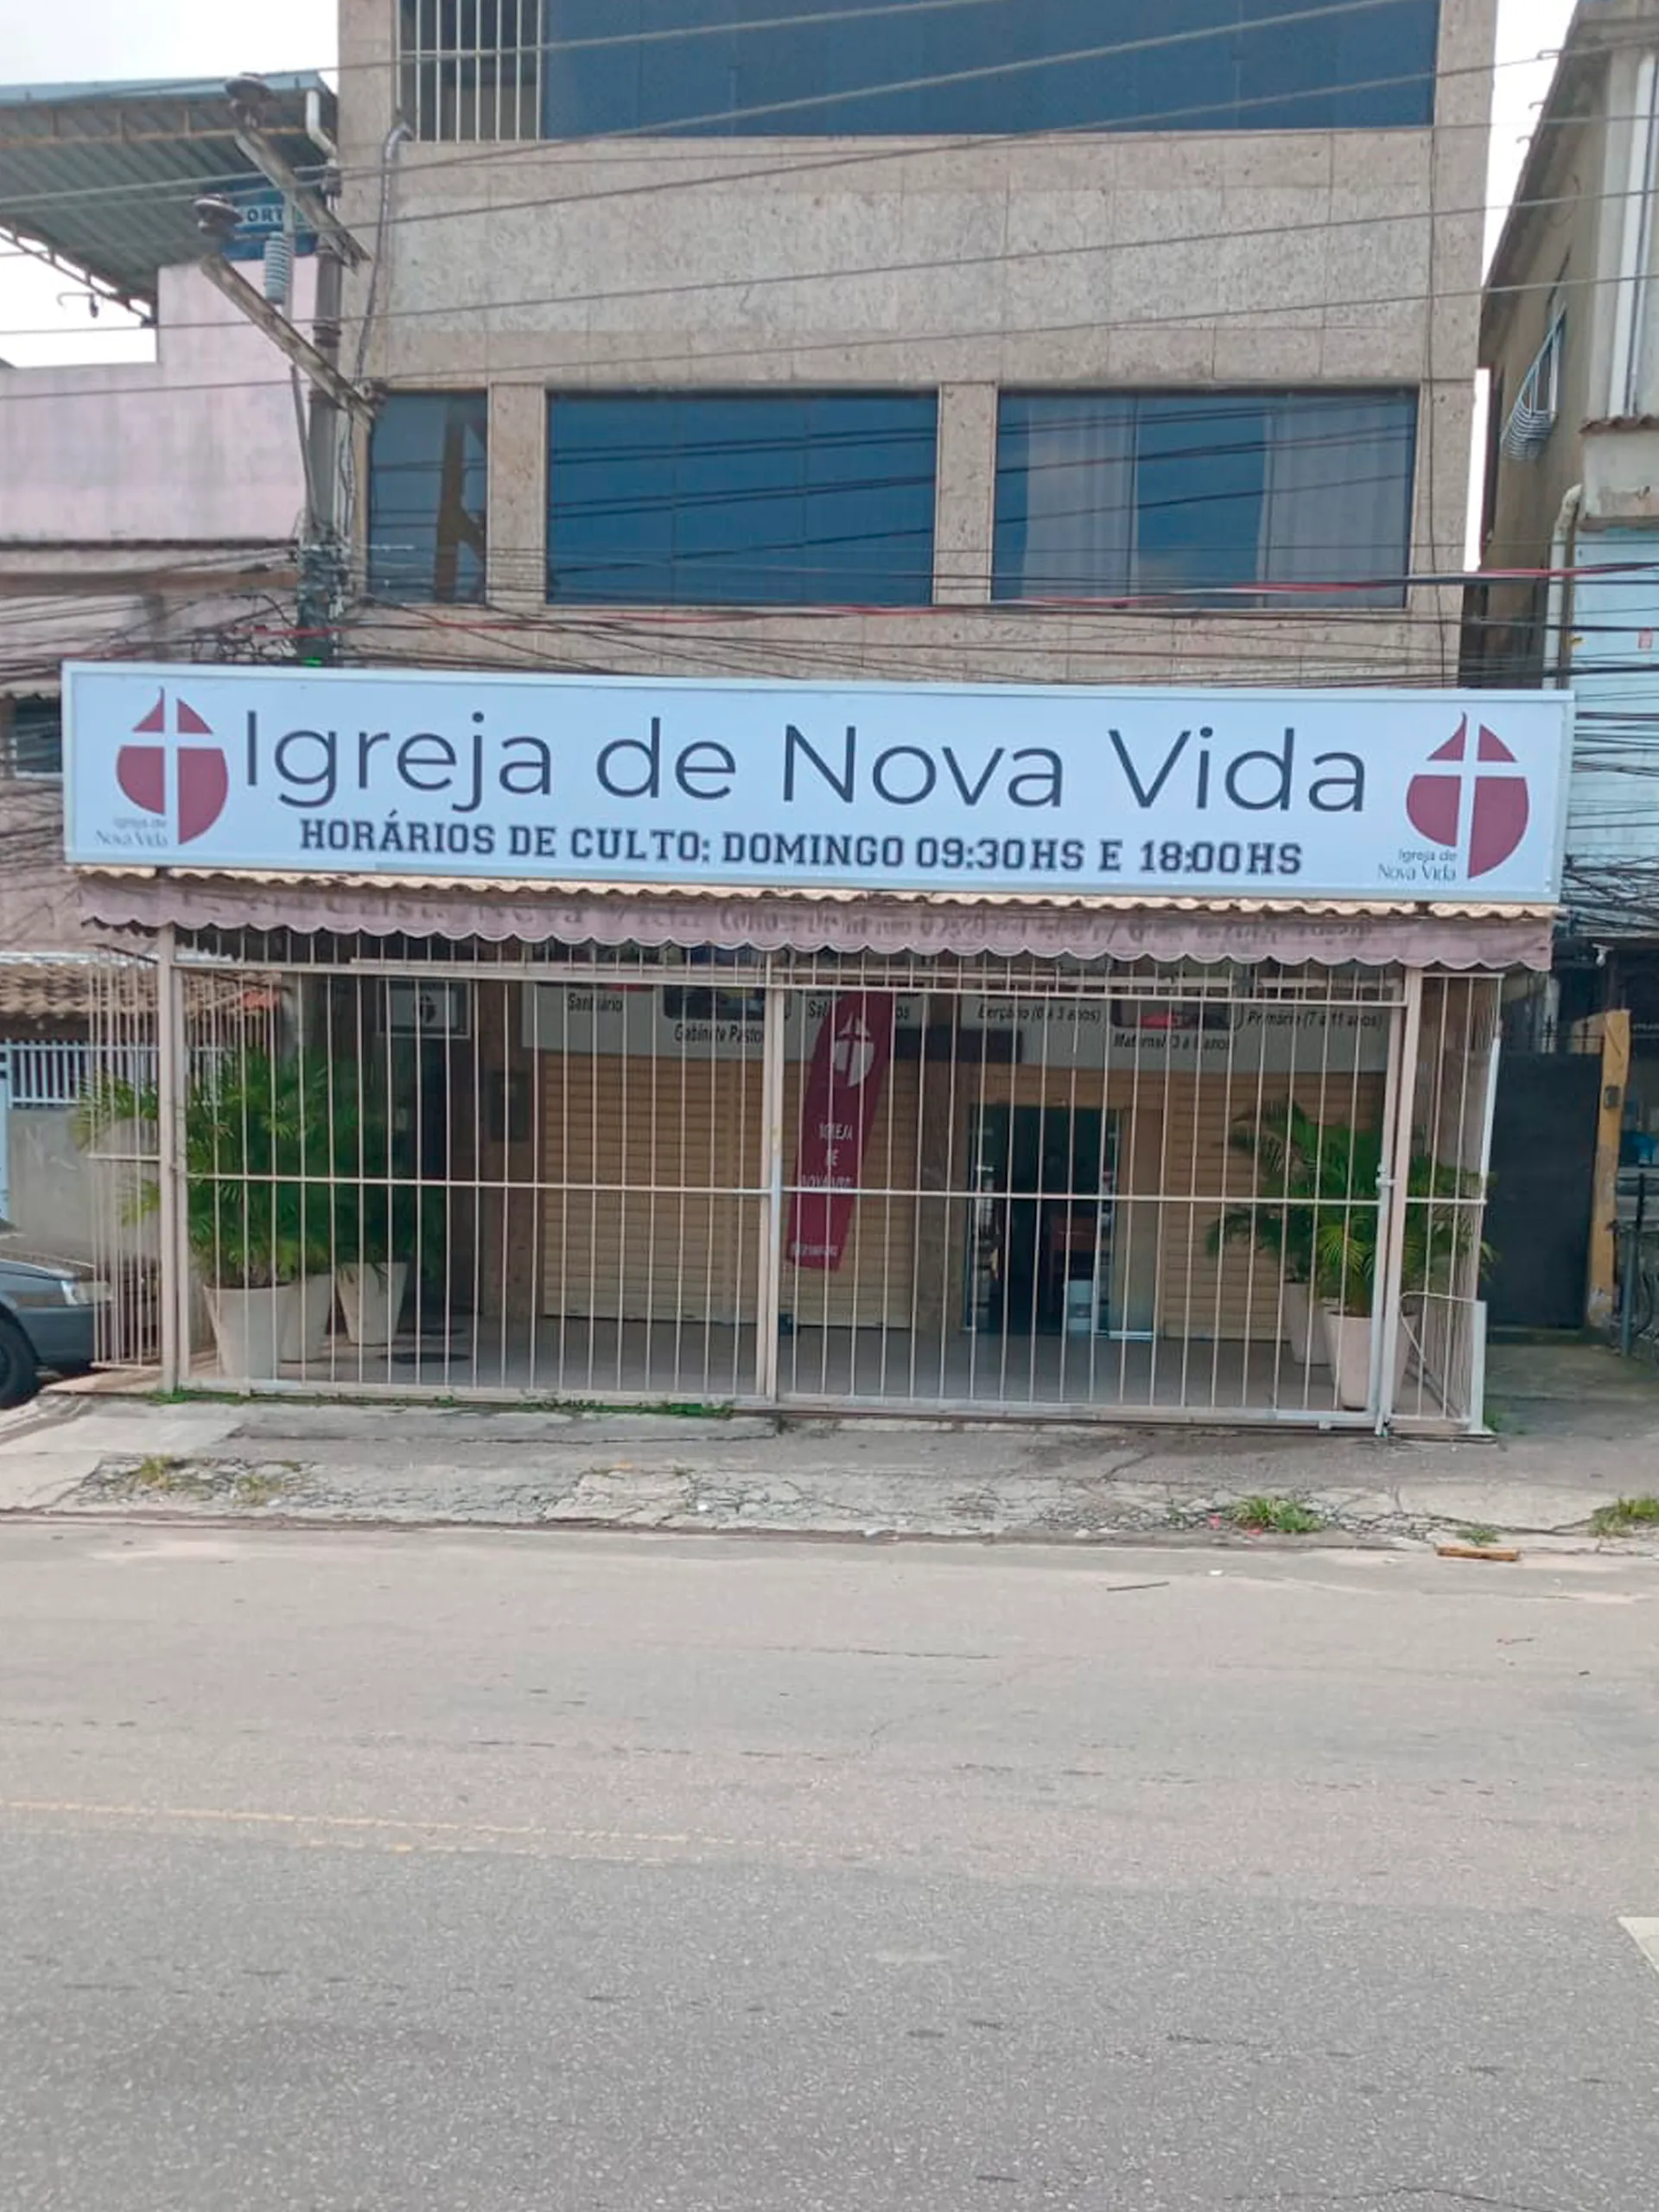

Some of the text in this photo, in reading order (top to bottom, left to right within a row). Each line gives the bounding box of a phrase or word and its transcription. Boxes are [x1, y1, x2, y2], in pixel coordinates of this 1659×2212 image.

[246, 709, 1366, 813] Igreja de Nova Vida
[301, 810, 1303, 874] HORÁRIOS DE CULTO: DOMINGO 09:30HS E 18:00HS
[1398, 849, 1458, 863] Igreja de
[1377, 863, 1457, 881] Nova Vida
[1247, 1010, 1301, 1027] Prmáro
[673, 1022, 728, 1042] Gabinte
[1113, 1033, 1166, 1049] Matrnal
